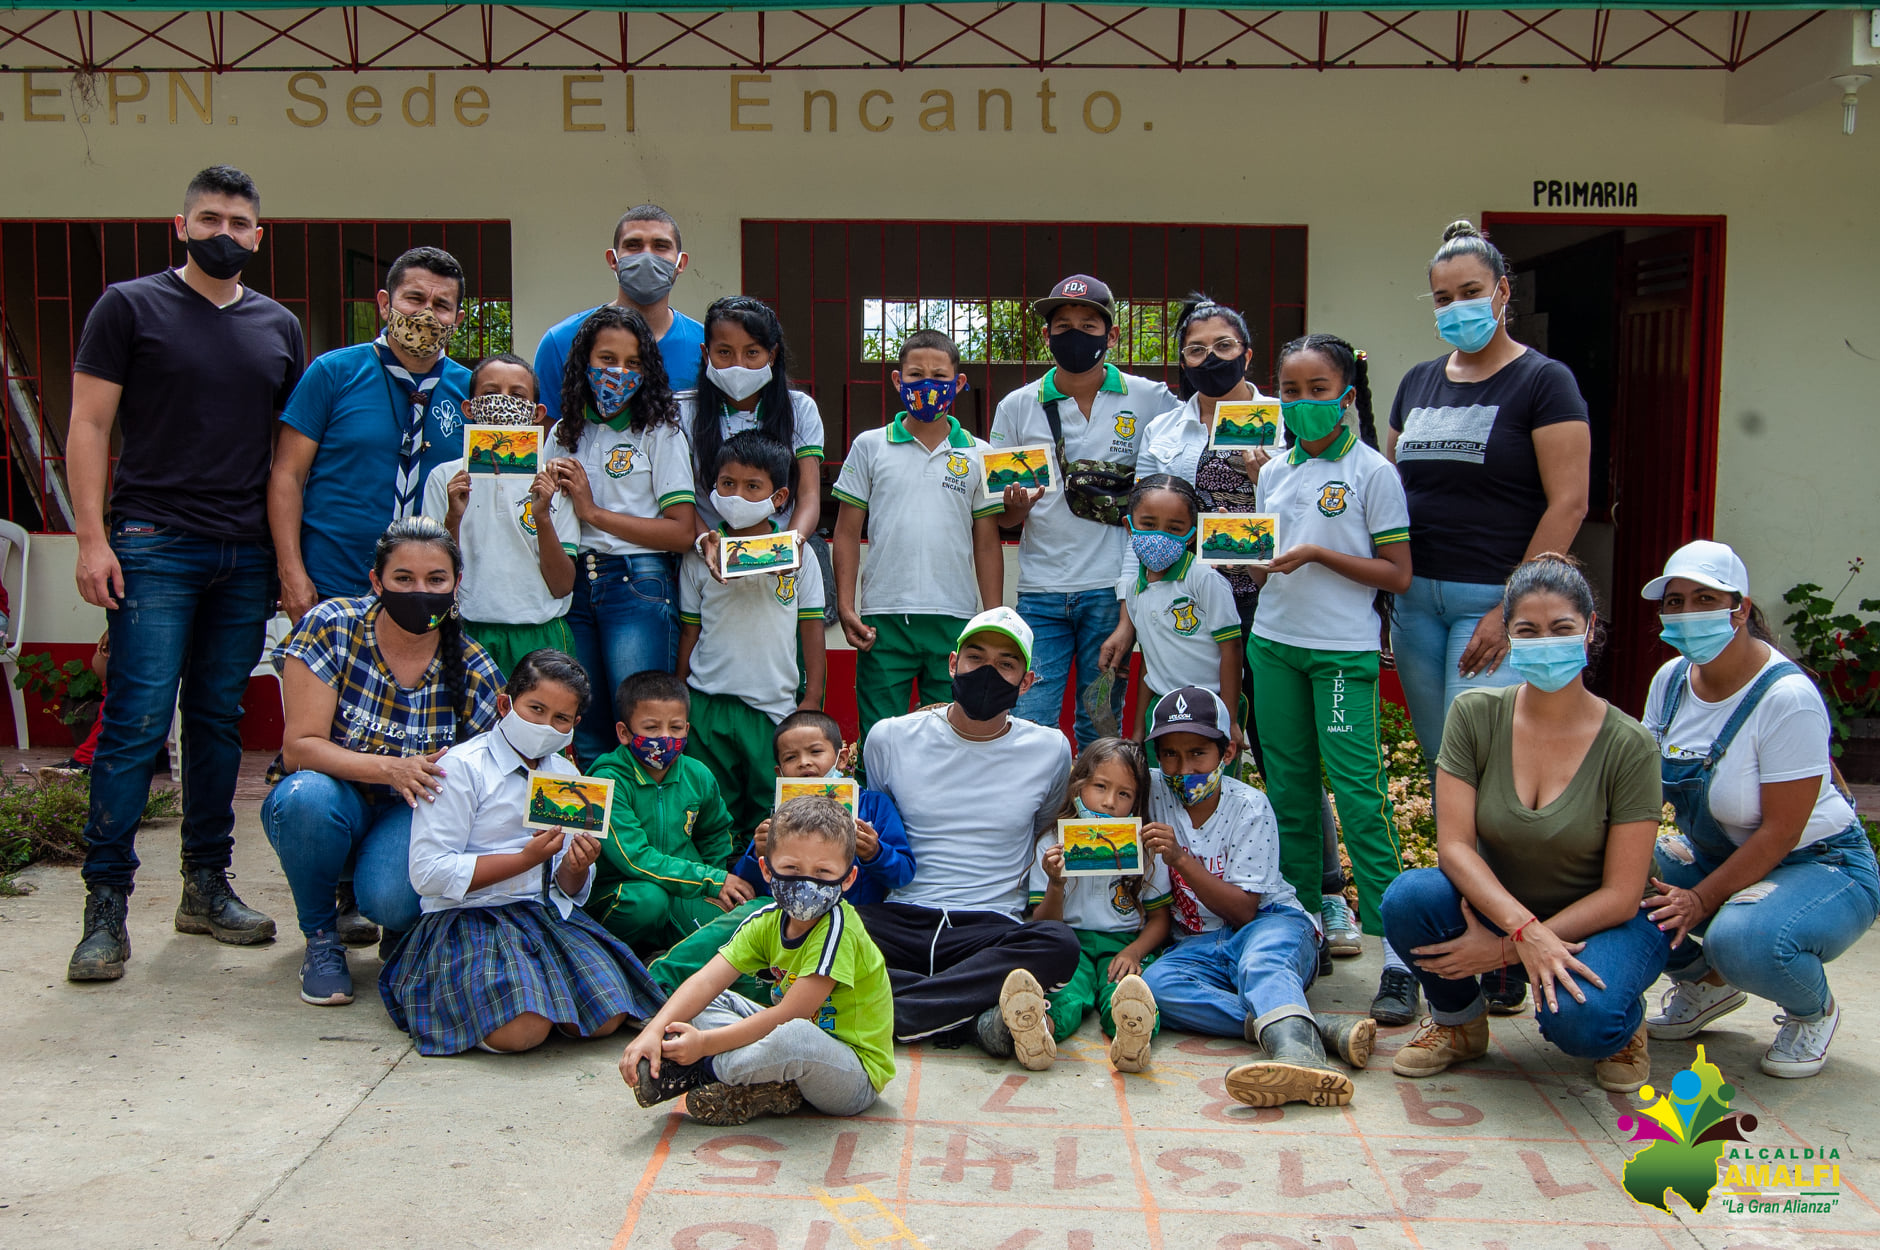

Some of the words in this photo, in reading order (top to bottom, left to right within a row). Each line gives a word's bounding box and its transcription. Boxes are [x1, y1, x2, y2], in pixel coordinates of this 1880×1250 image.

[286, 71, 491, 128] Sede
[563, 74, 635, 132] El
[730, 74, 1153, 134] Encanto.
[1532, 180, 1638, 207] PRIMARIA
[1064, 282, 1086, 293] FOX
[1404, 441, 1427, 450] LET'S
[1430, 441, 1442, 449] BE
[1444, 441, 1487, 452] MYSELF
[1326, 725, 1353, 733] AMALFI
